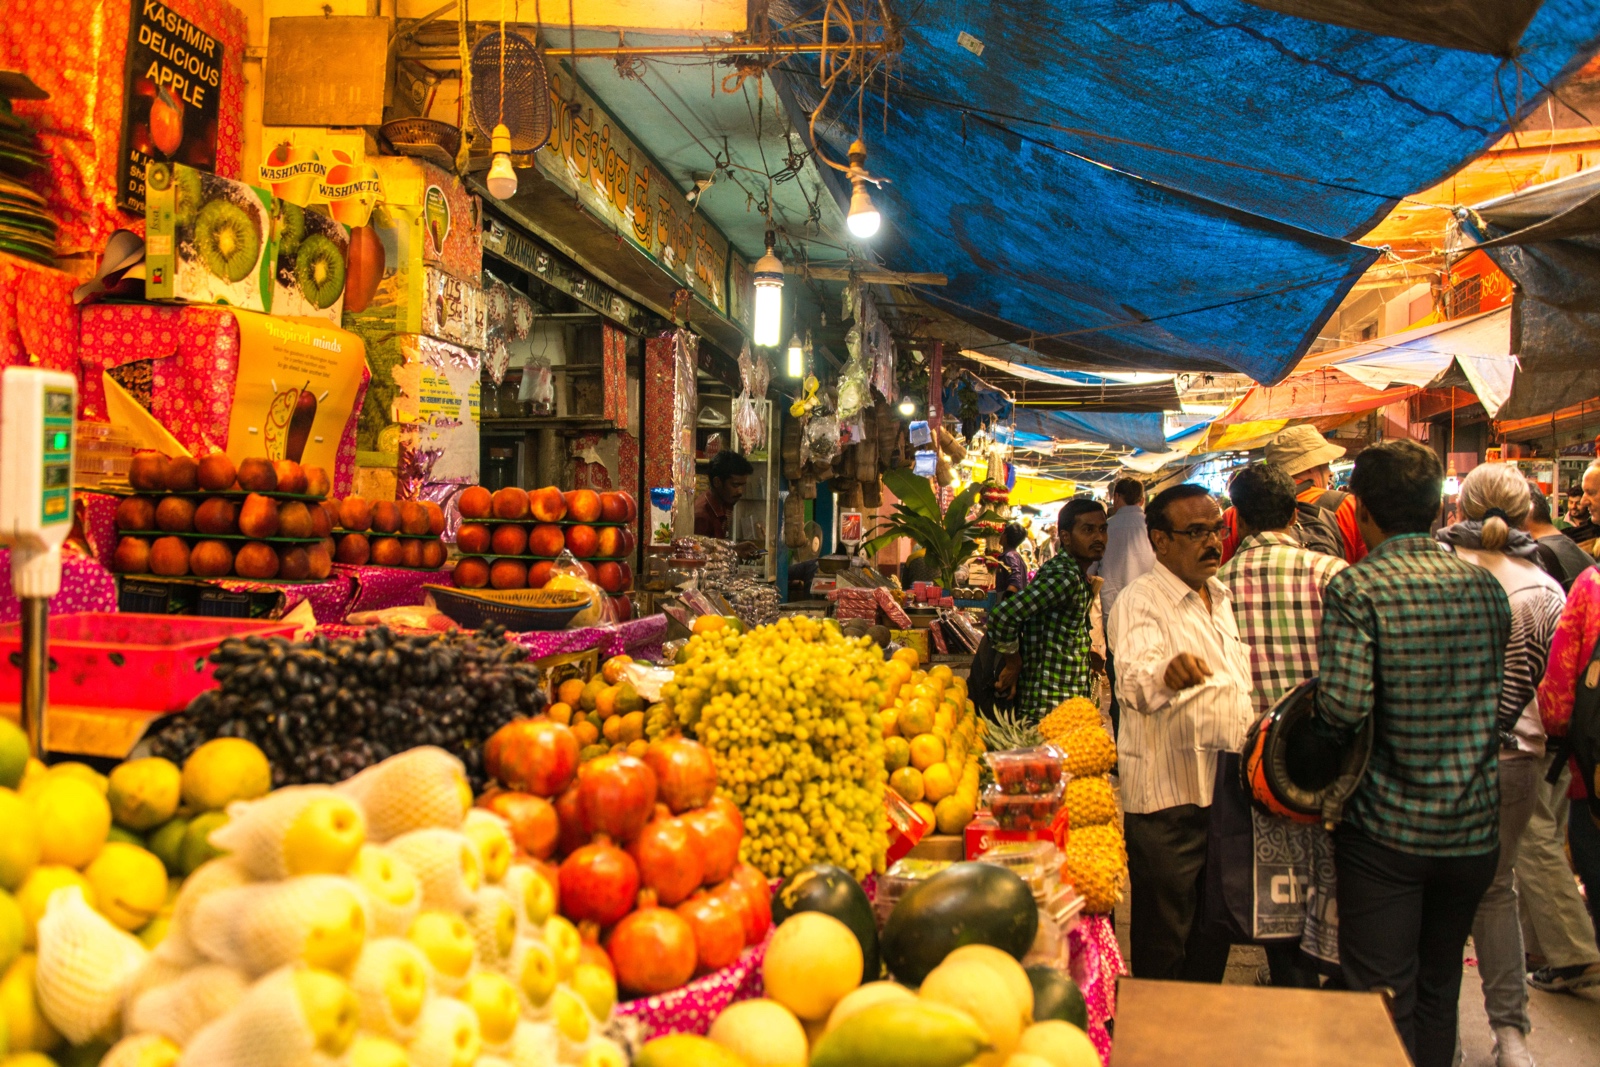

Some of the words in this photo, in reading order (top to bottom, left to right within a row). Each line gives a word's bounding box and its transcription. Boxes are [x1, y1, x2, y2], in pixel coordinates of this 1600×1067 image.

[143, 0, 215, 58] KASHMIR
[138, 23, 219, 87] DELICIOUS
[145, 60, 205, 109] APPLE
[260, 162, 327, 179] WASHINGTON
[319, 180, 382, 197] WASHINGTO
[265, 321, 310, 345] Inspired
[313, 336, 342, 353] minds
